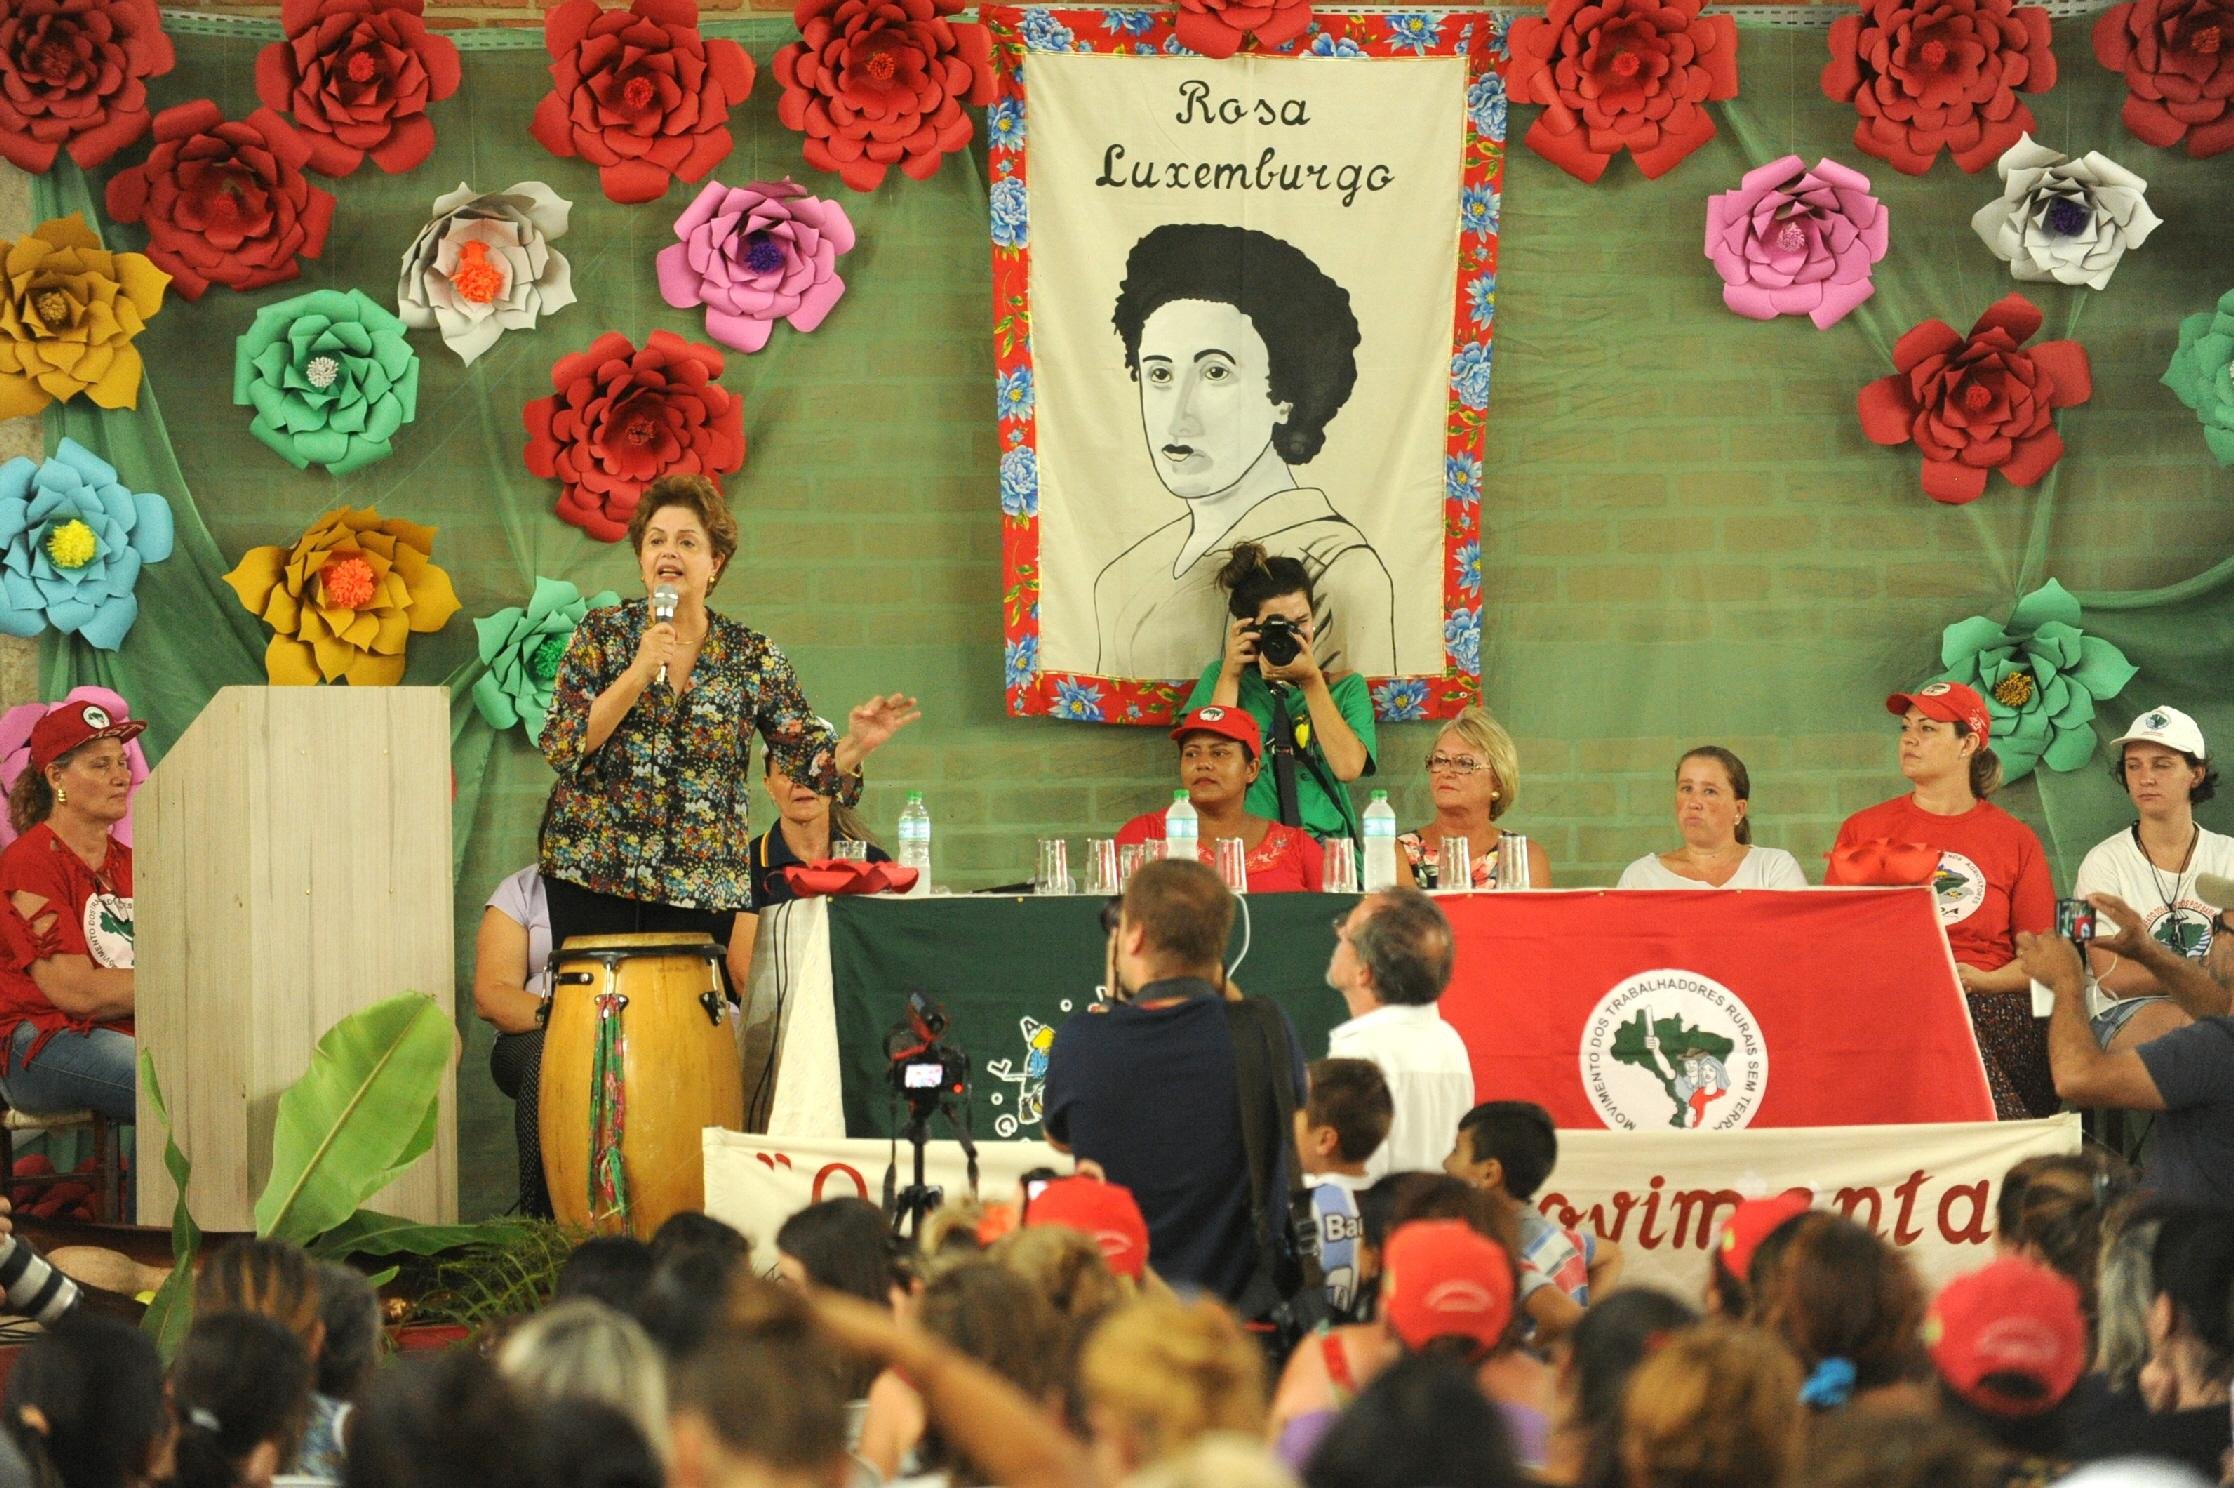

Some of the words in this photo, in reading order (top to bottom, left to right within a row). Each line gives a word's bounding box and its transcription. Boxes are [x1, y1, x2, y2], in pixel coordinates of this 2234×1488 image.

[1175, 79, 1311, 126] Rosa
[1095, 143, 1396, 208] Luxemburgo
[1605, 978, 1725, 1016] TRABALHADORES
[1591, 1018, 1610, 1048] DOS
[1726, 1004, 1758, 1056] RURAIS
[1589, 1052, 1637, 1131] MOVIMENTO
[1744, 1060, 1760, 1092] SEM
